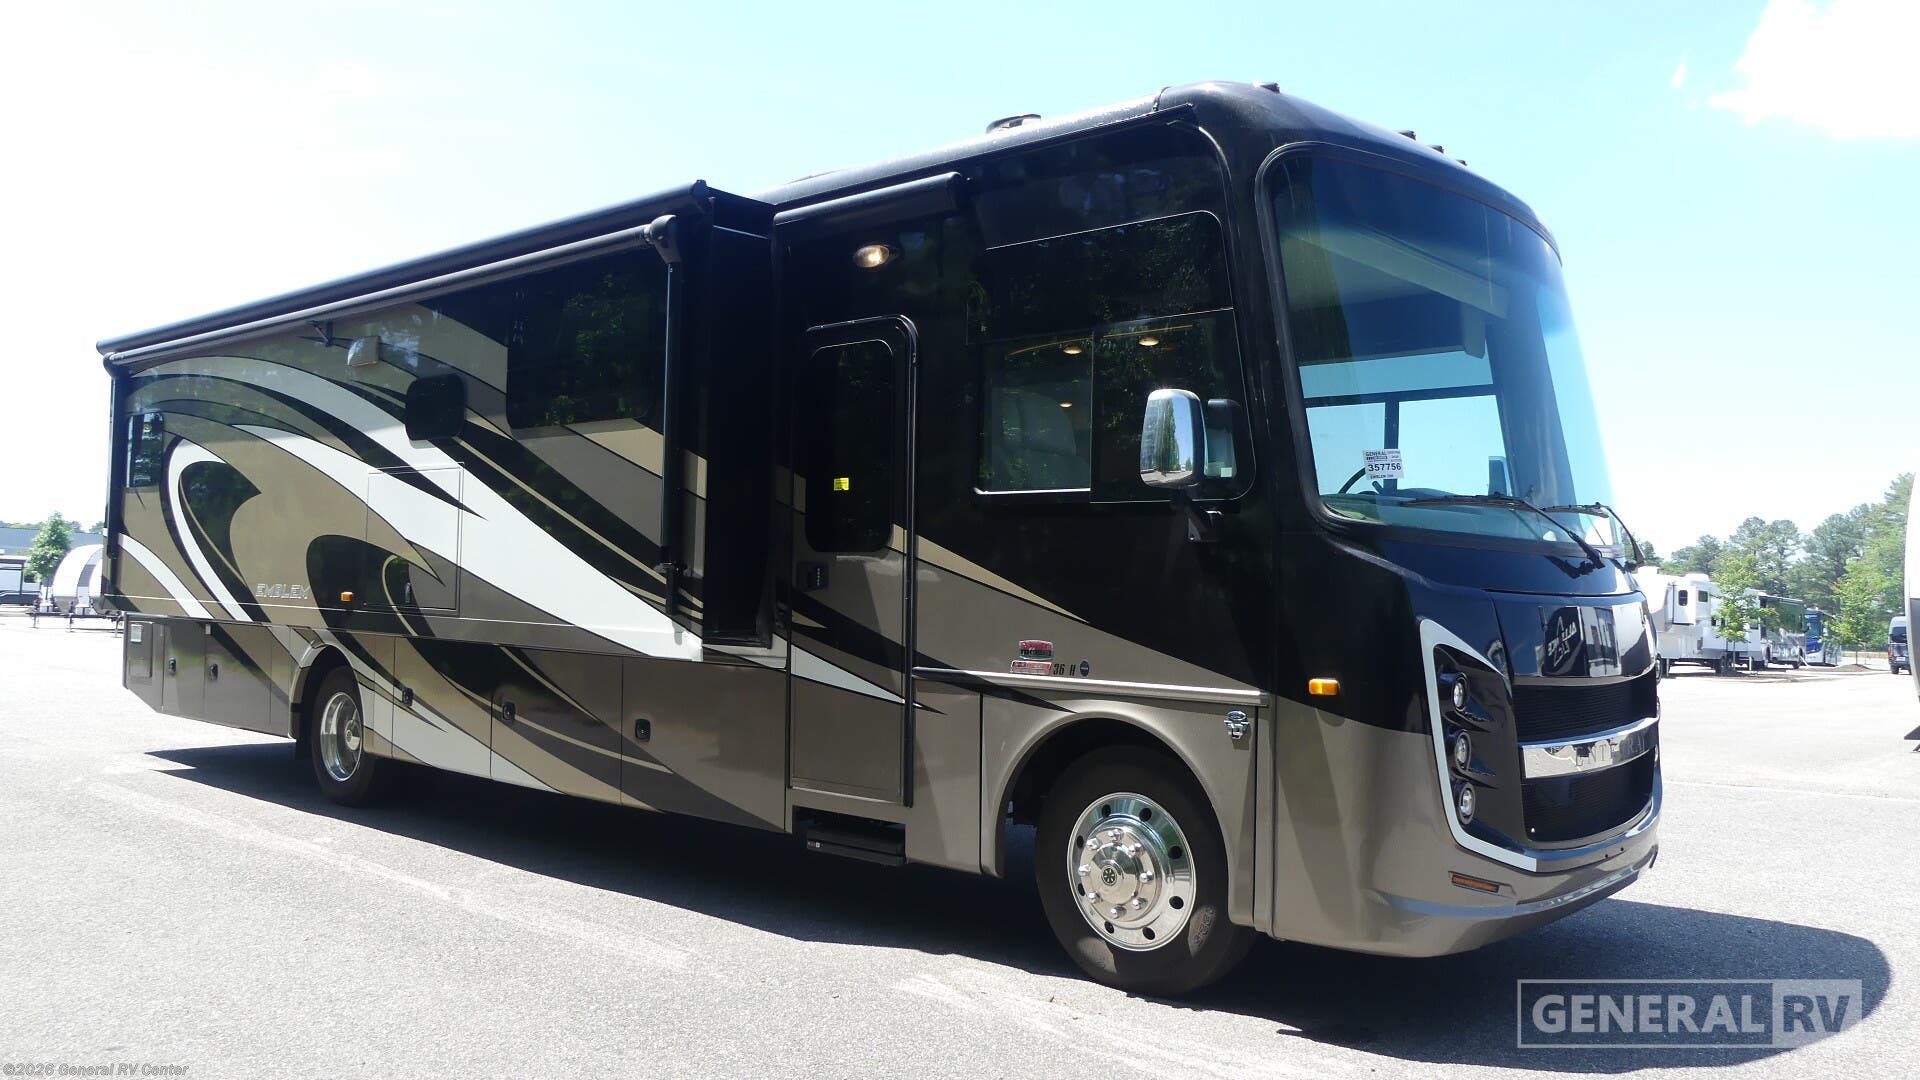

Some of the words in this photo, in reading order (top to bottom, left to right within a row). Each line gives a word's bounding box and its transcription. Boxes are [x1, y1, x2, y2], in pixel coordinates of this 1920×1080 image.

[1368, 463, 1402, 472] 357756
[255, 583, 310, 600] EMBLEM
[1053, 663, 1065, 676] 36
